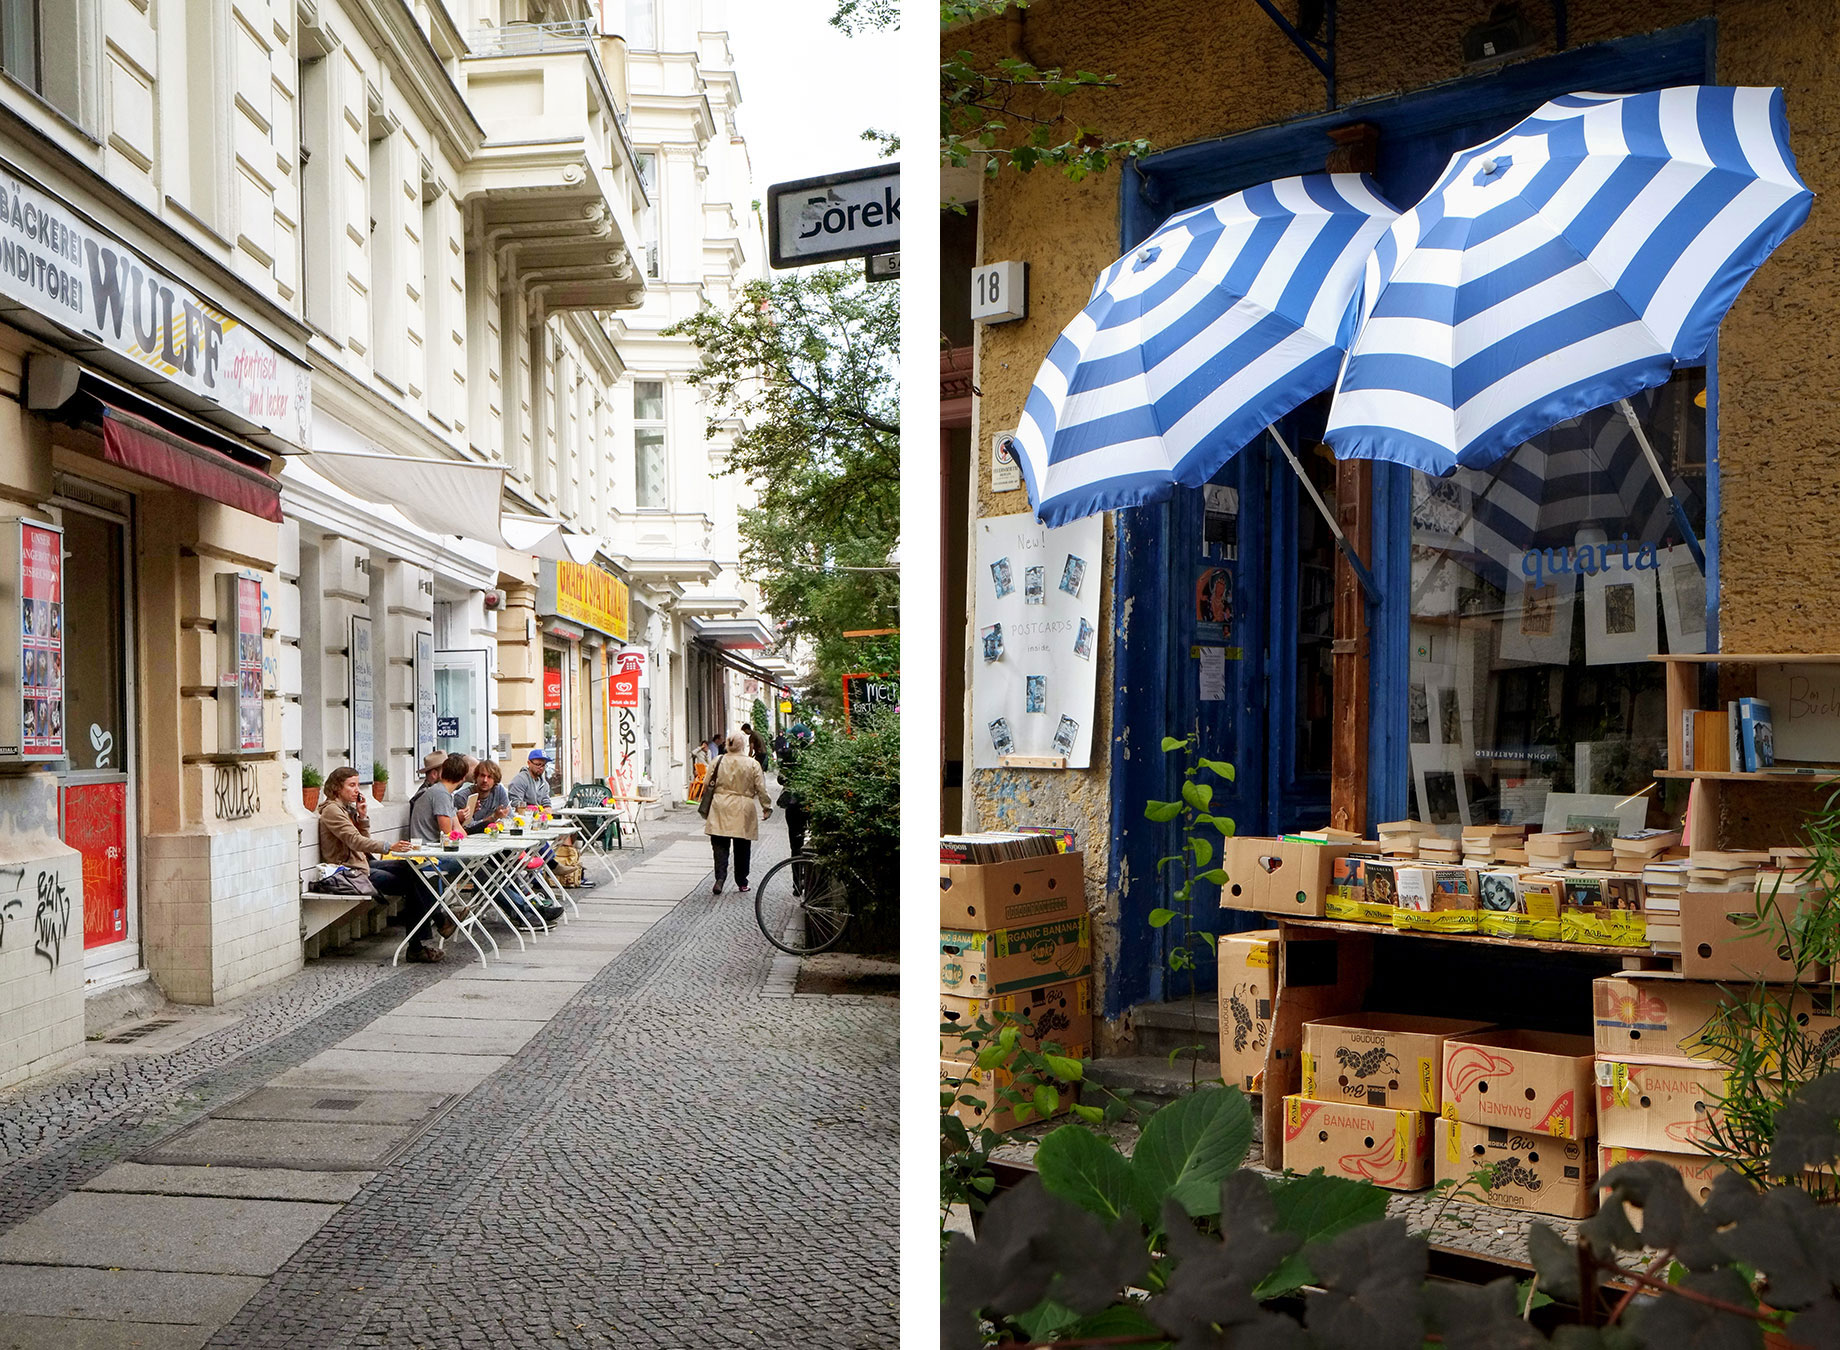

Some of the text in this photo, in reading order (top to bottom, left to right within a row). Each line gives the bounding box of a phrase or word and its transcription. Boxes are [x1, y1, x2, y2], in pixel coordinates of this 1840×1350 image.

[0, 181, 82, 268] BÄCKEREI
[889, 256, 900, 270] 5
[977, 271, 1000, 306] 18
[84, 238, 223, 389] WULFF
[266, 388, 289, 418] lecker
[31, 532, 51, 547] UNSER
[1018, 531, 1047, 550] New!
[1521, 532, 1660, 589] quaria
[1012, 620, 1073, 636] POSTCARDS
[1027, 644, 1050, 653] inside
[437, 729, 457, 737] OPEN
[1475, 750, 1551, 760] JOHN HEARTFIELD
[1001, 930, 1041, 944] RGANIC
[1046, 989, 1063, 1003] Bio
[1597, 986, 1668, 1022] Dole
[1222, 998, 1230, 1036] Bananen
[1255, 1021, 1267, 1048] Bio
[1351, 1033, 1386, 1047] Bananen
[1342, 1084, 1367, 1098] Bio
[1478, 1100, 1531, 1120] BANANEN
[1323, 1113, 1375, 1131] BANANEN
[1509, 1136, 1535, 1151] Bio
[1675, 1165, 1712, 1180] ANEN
[1487, 1191, 1525, 1206] Bananen
